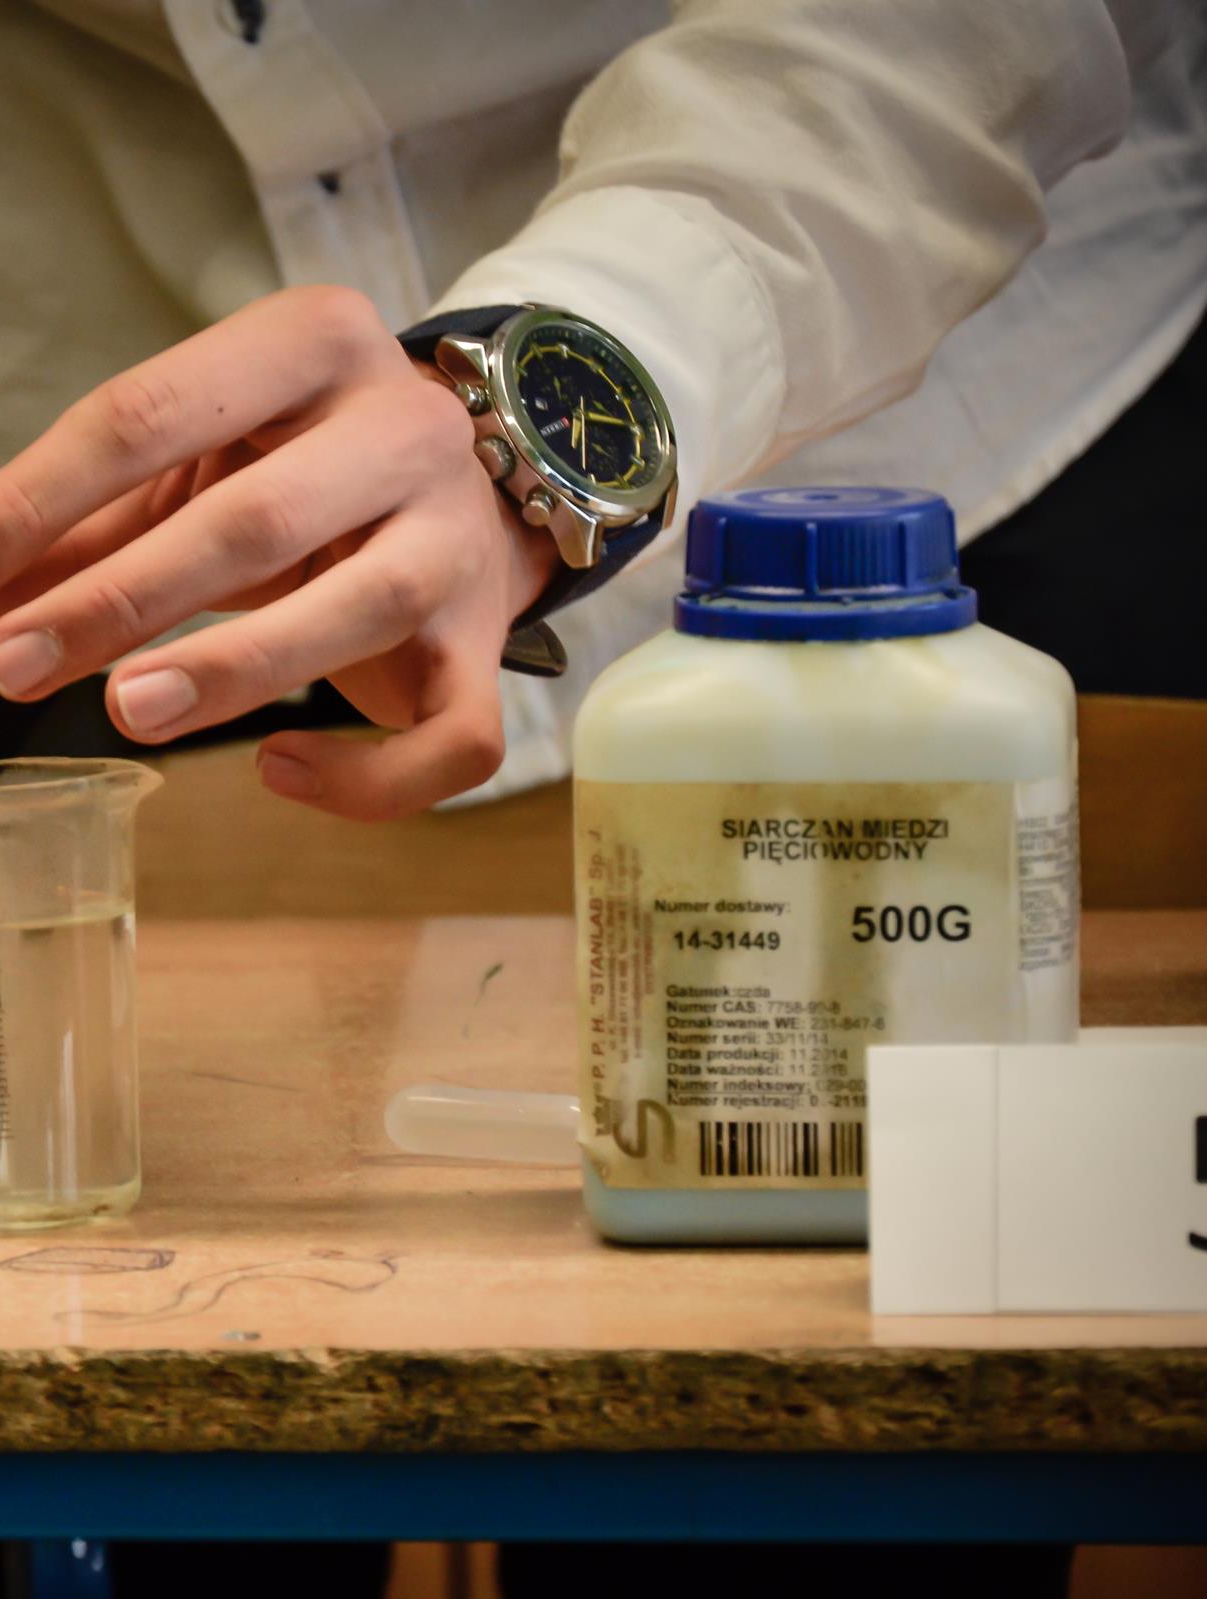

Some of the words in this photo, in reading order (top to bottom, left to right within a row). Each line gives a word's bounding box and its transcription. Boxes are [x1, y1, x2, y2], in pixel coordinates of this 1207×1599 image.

[721, 819, 854, 839] SIARCZAN
[862, 819, 948, 839] MIEDZI
[743, 841, 929, 864] PIĘCIOWODNY
[654, 899, 710, 913] Numer
[714, 899, 791, 916] dostawy:
[851, 905, 971, 943] 500G
[674, 931, 780, 951] 14-31449
[666, 1001, 718, 1014] Numer
[722, 1001, 761, 1014] CAS:
[666, 1017, 769, 1030] Oznakowanie
[775, 1016, 806, 1030] WE:
[666, 1032, 718, 1045] Numer
[722, 1032, 760, 1045] serii:
[666, 1048, 702, 1060] Data
[707, 1047, 784, 1063] produkcji:
[666, 1063, 702, 1076] Data
[666, 1079, 718, 1092] Numer
[667, 1095, 718, 1108] Numer
